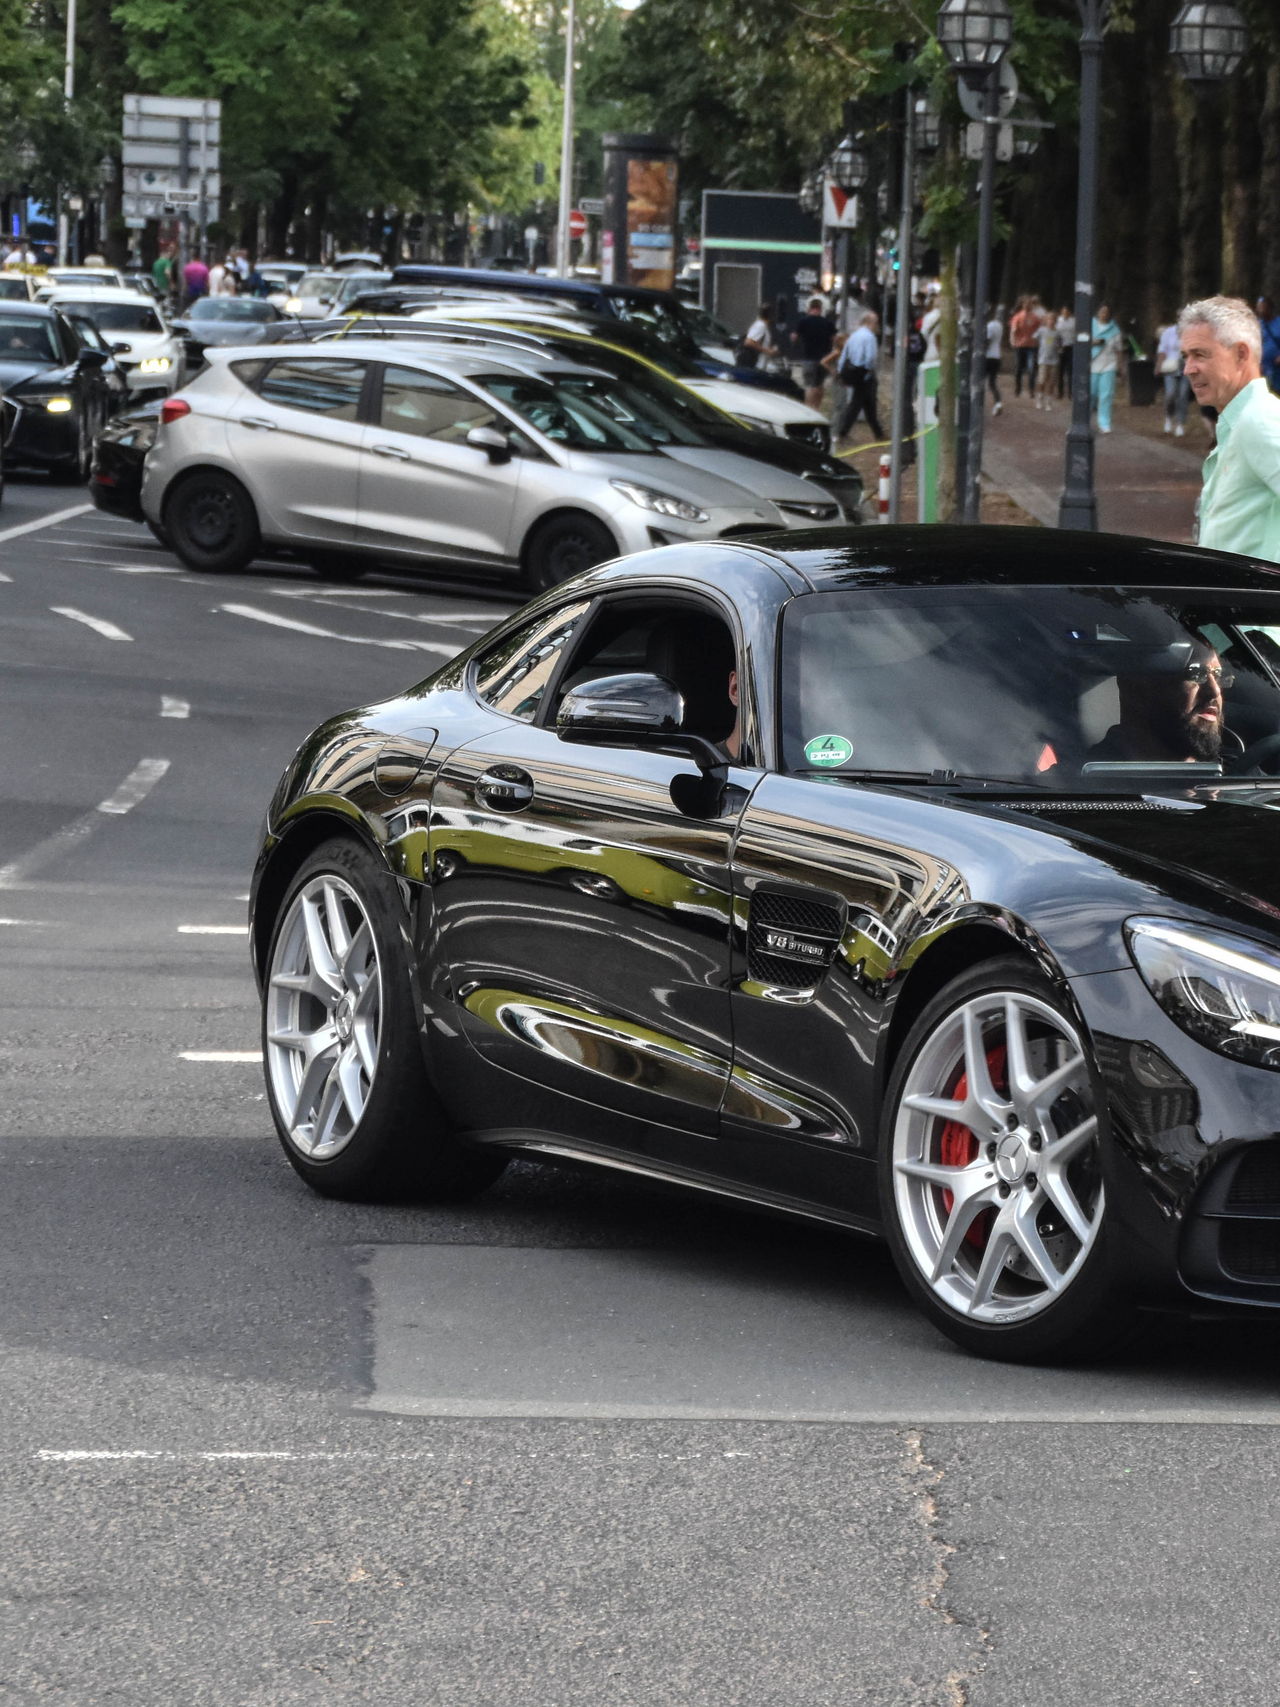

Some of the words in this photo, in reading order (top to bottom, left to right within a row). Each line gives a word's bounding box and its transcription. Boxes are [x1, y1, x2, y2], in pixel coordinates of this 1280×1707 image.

[821, 737, 835, 751] 4
[766, 933, 788, 949] V8
[788, 942, 824, 956] BITURBO
